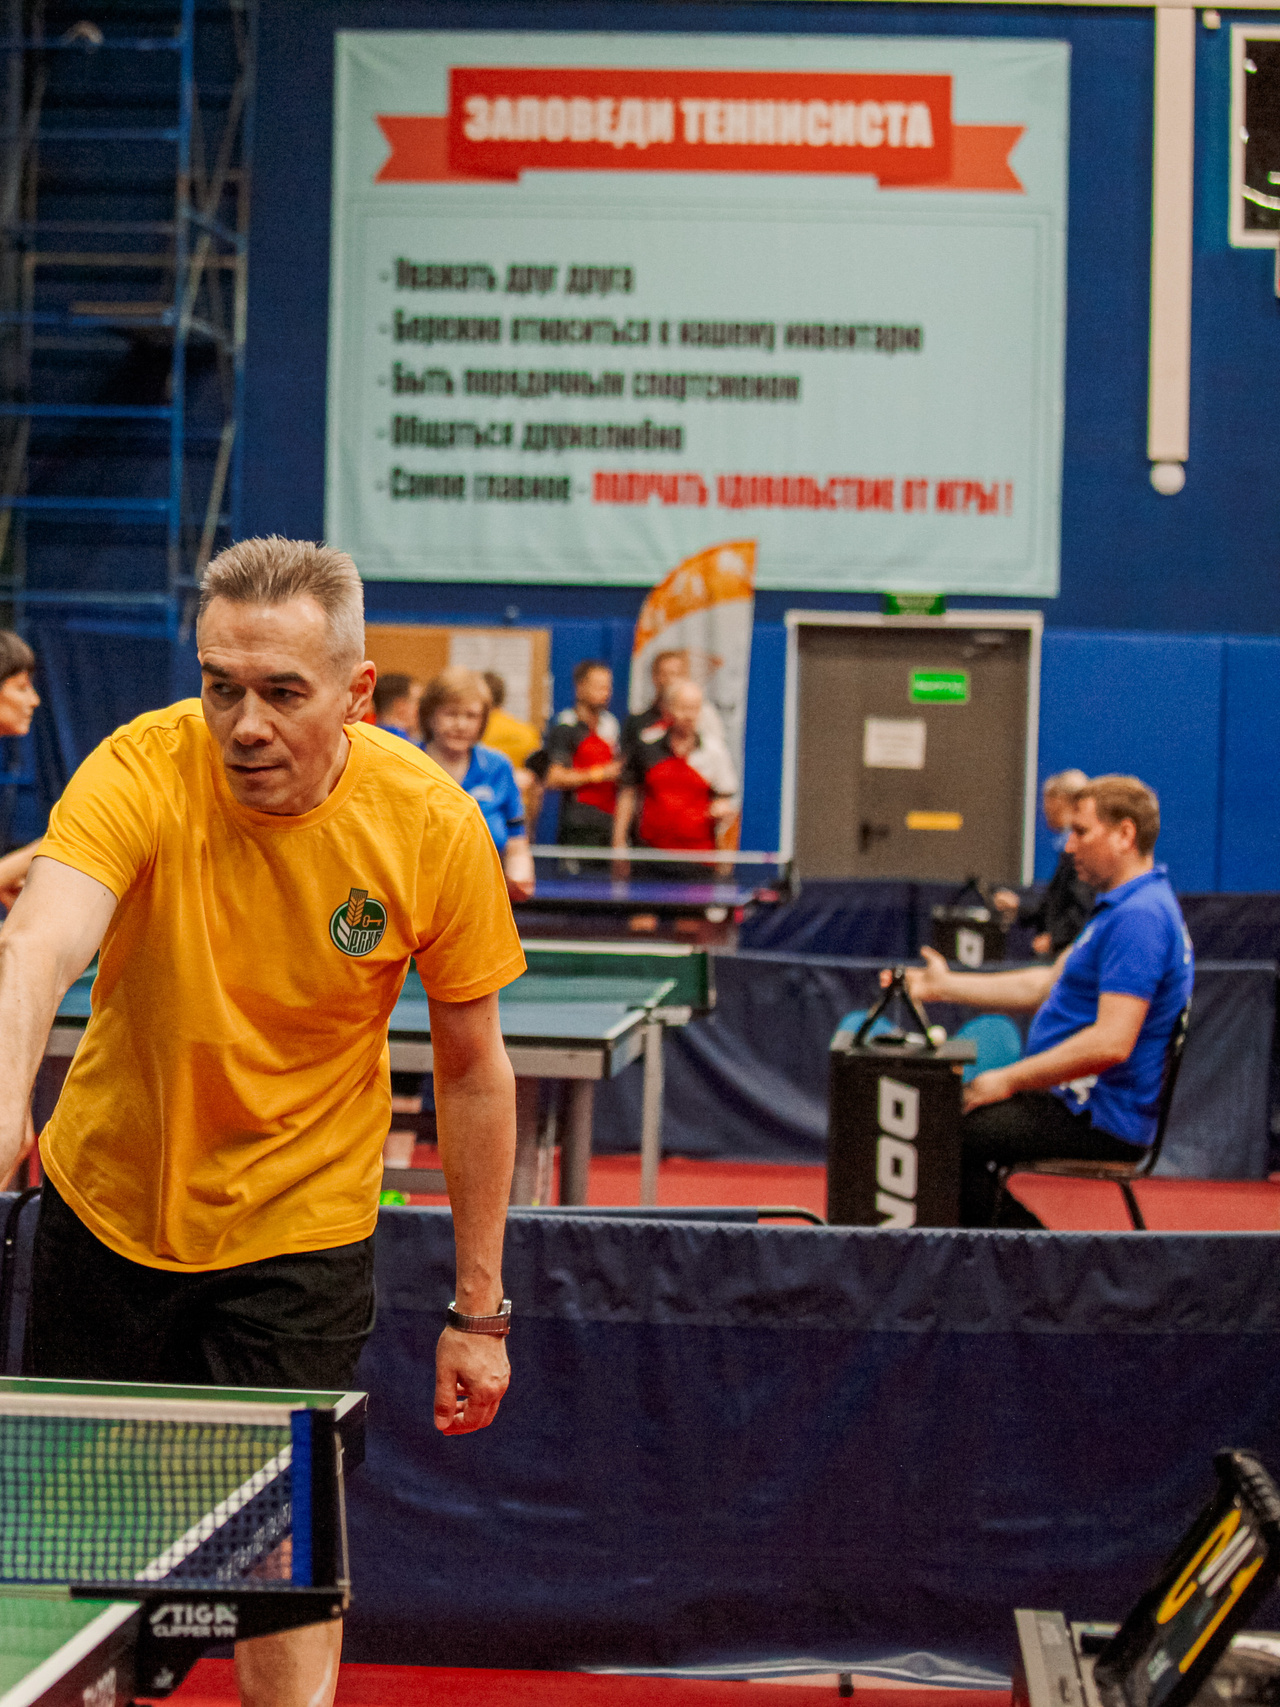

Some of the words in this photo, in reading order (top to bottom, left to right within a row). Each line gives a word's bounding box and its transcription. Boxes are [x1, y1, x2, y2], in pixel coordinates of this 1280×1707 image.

[464, 97, 674, 149] ЗАПОВЕДИ
[681, 99, 933, 148] ТЕННИСИСТА
[149, 1603, 238, 1625] STIGA
